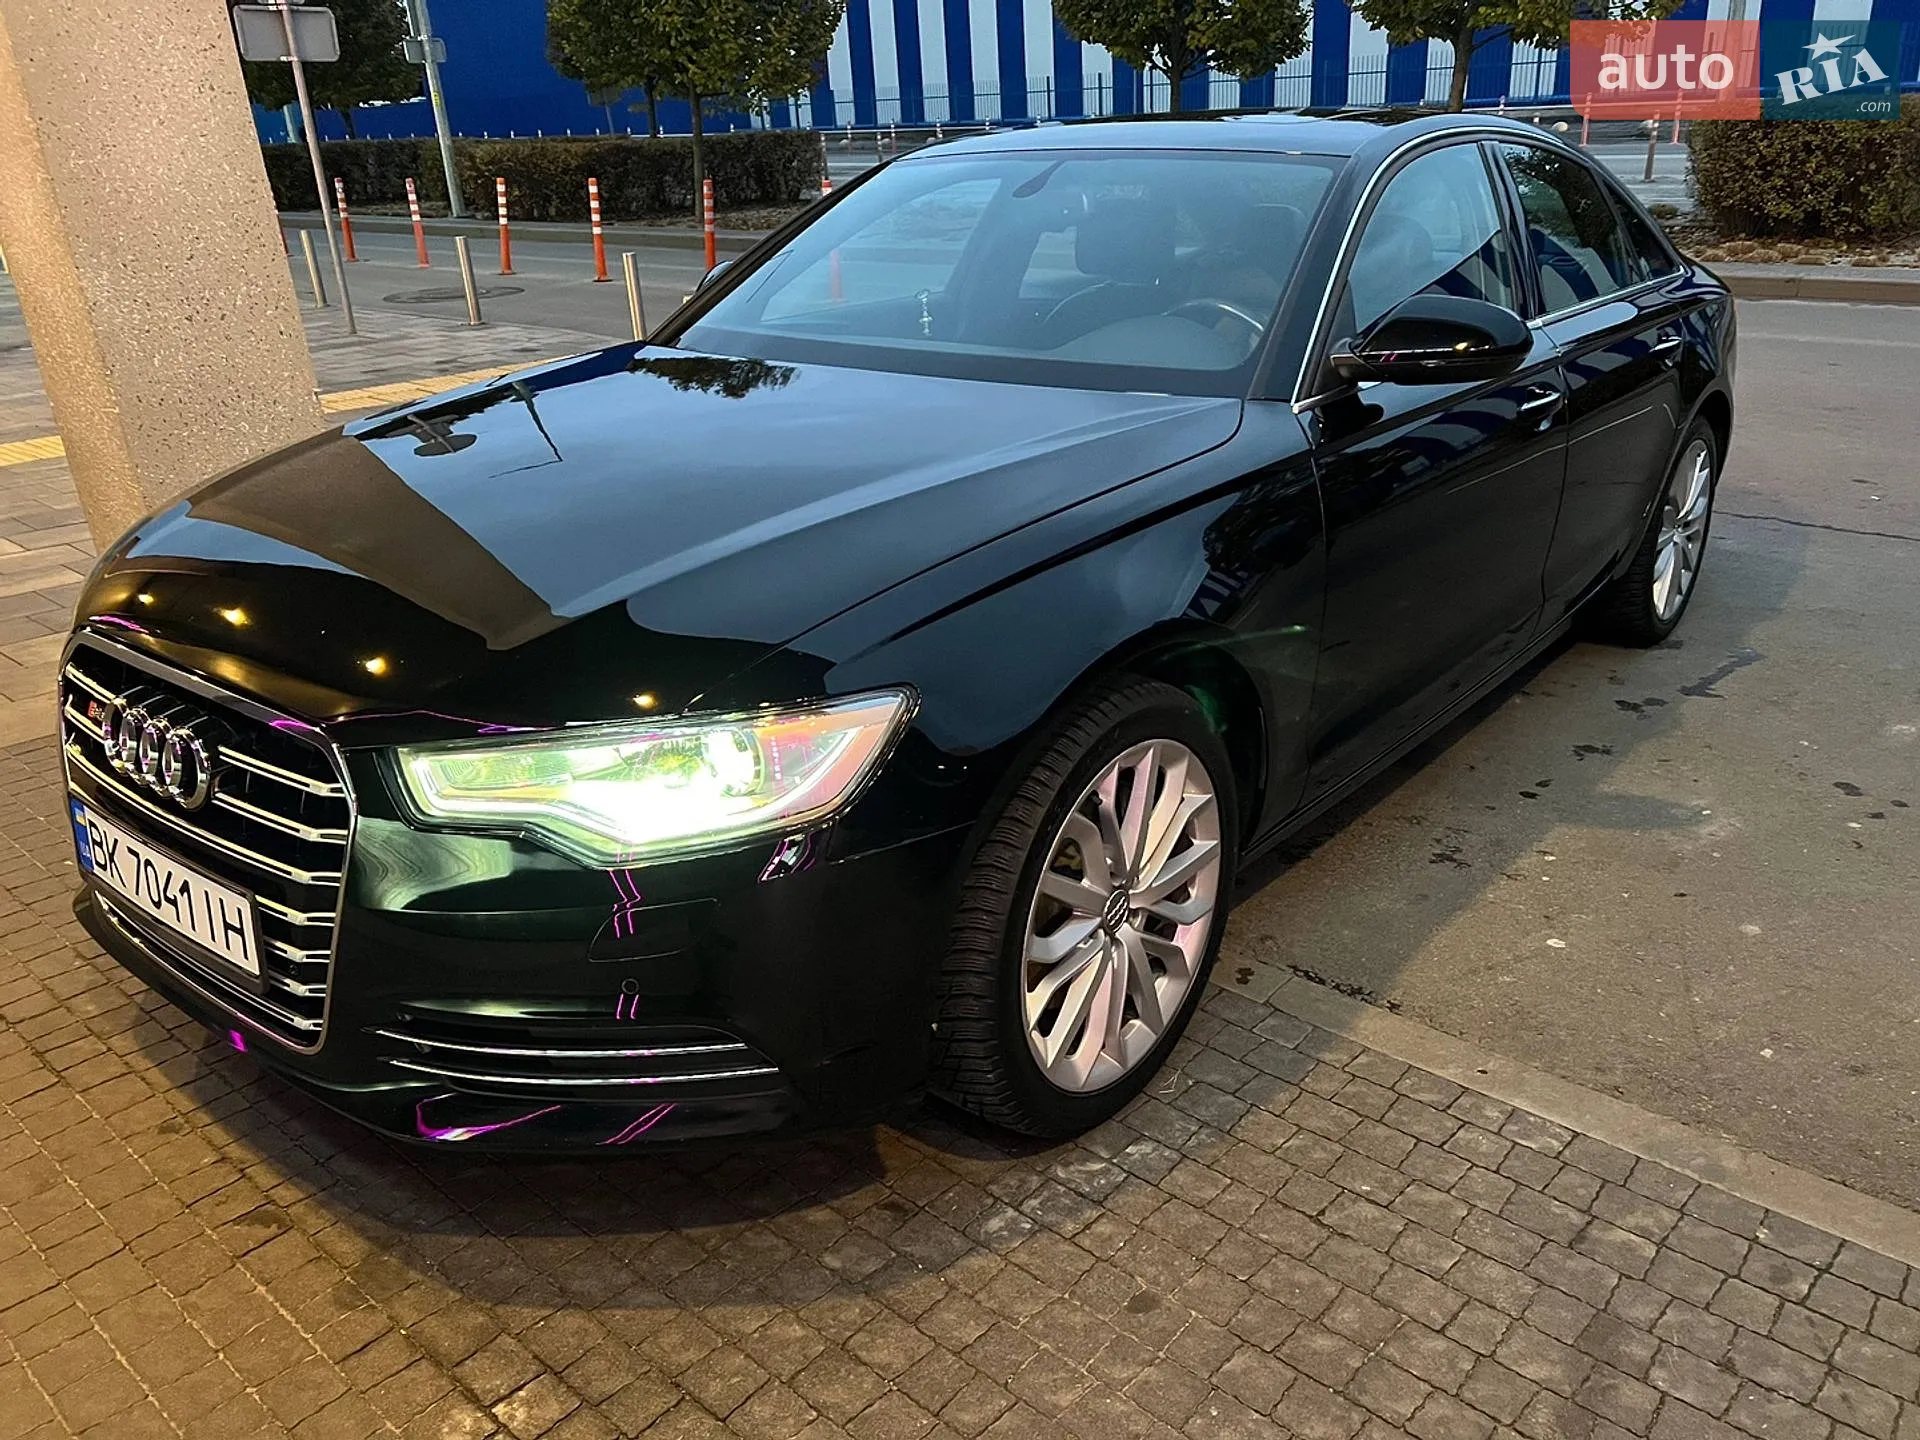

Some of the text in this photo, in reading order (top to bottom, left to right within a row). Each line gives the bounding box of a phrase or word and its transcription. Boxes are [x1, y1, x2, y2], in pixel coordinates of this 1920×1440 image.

[87, 819, 249, 961] BK 7041 IH
